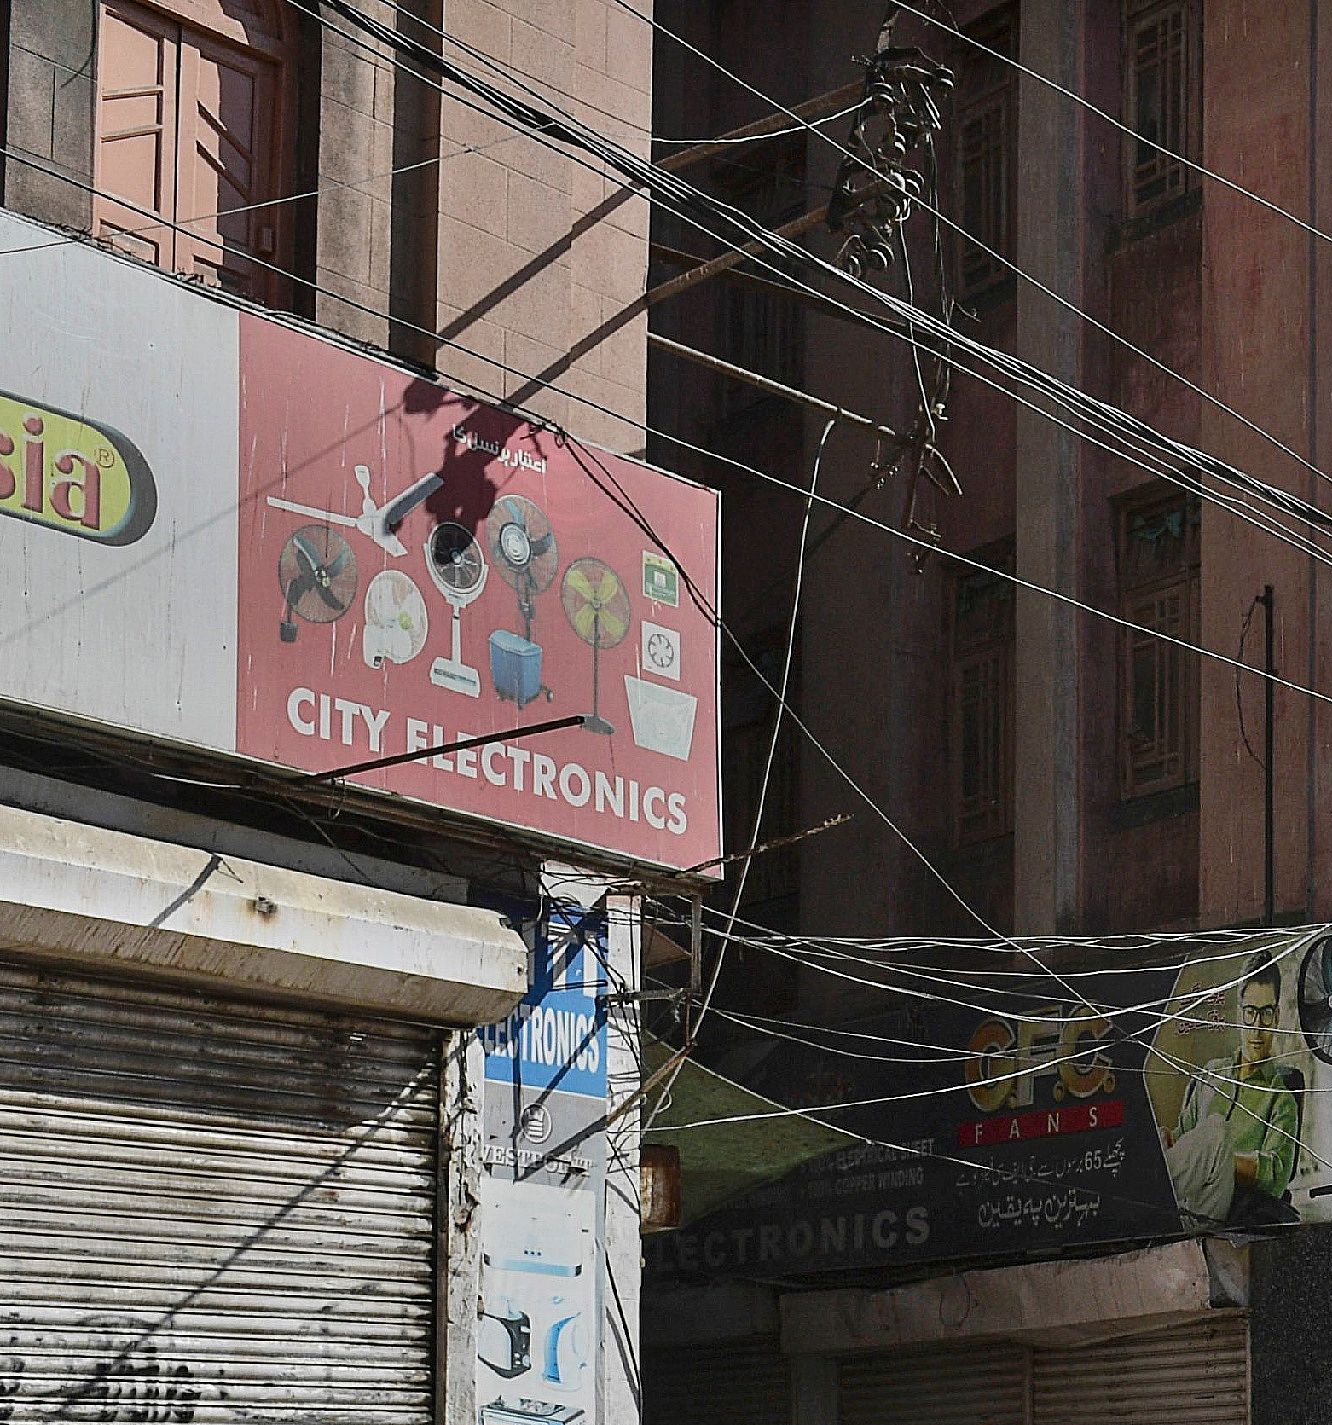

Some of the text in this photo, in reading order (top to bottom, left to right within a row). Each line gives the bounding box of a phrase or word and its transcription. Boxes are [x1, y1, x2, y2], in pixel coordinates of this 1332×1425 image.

[286, 686, 689, 836] CITY ELECTRONICS
[975, 1106, 1099, 1145] FANS
[1084, 1149, 1103, 1171] 65
